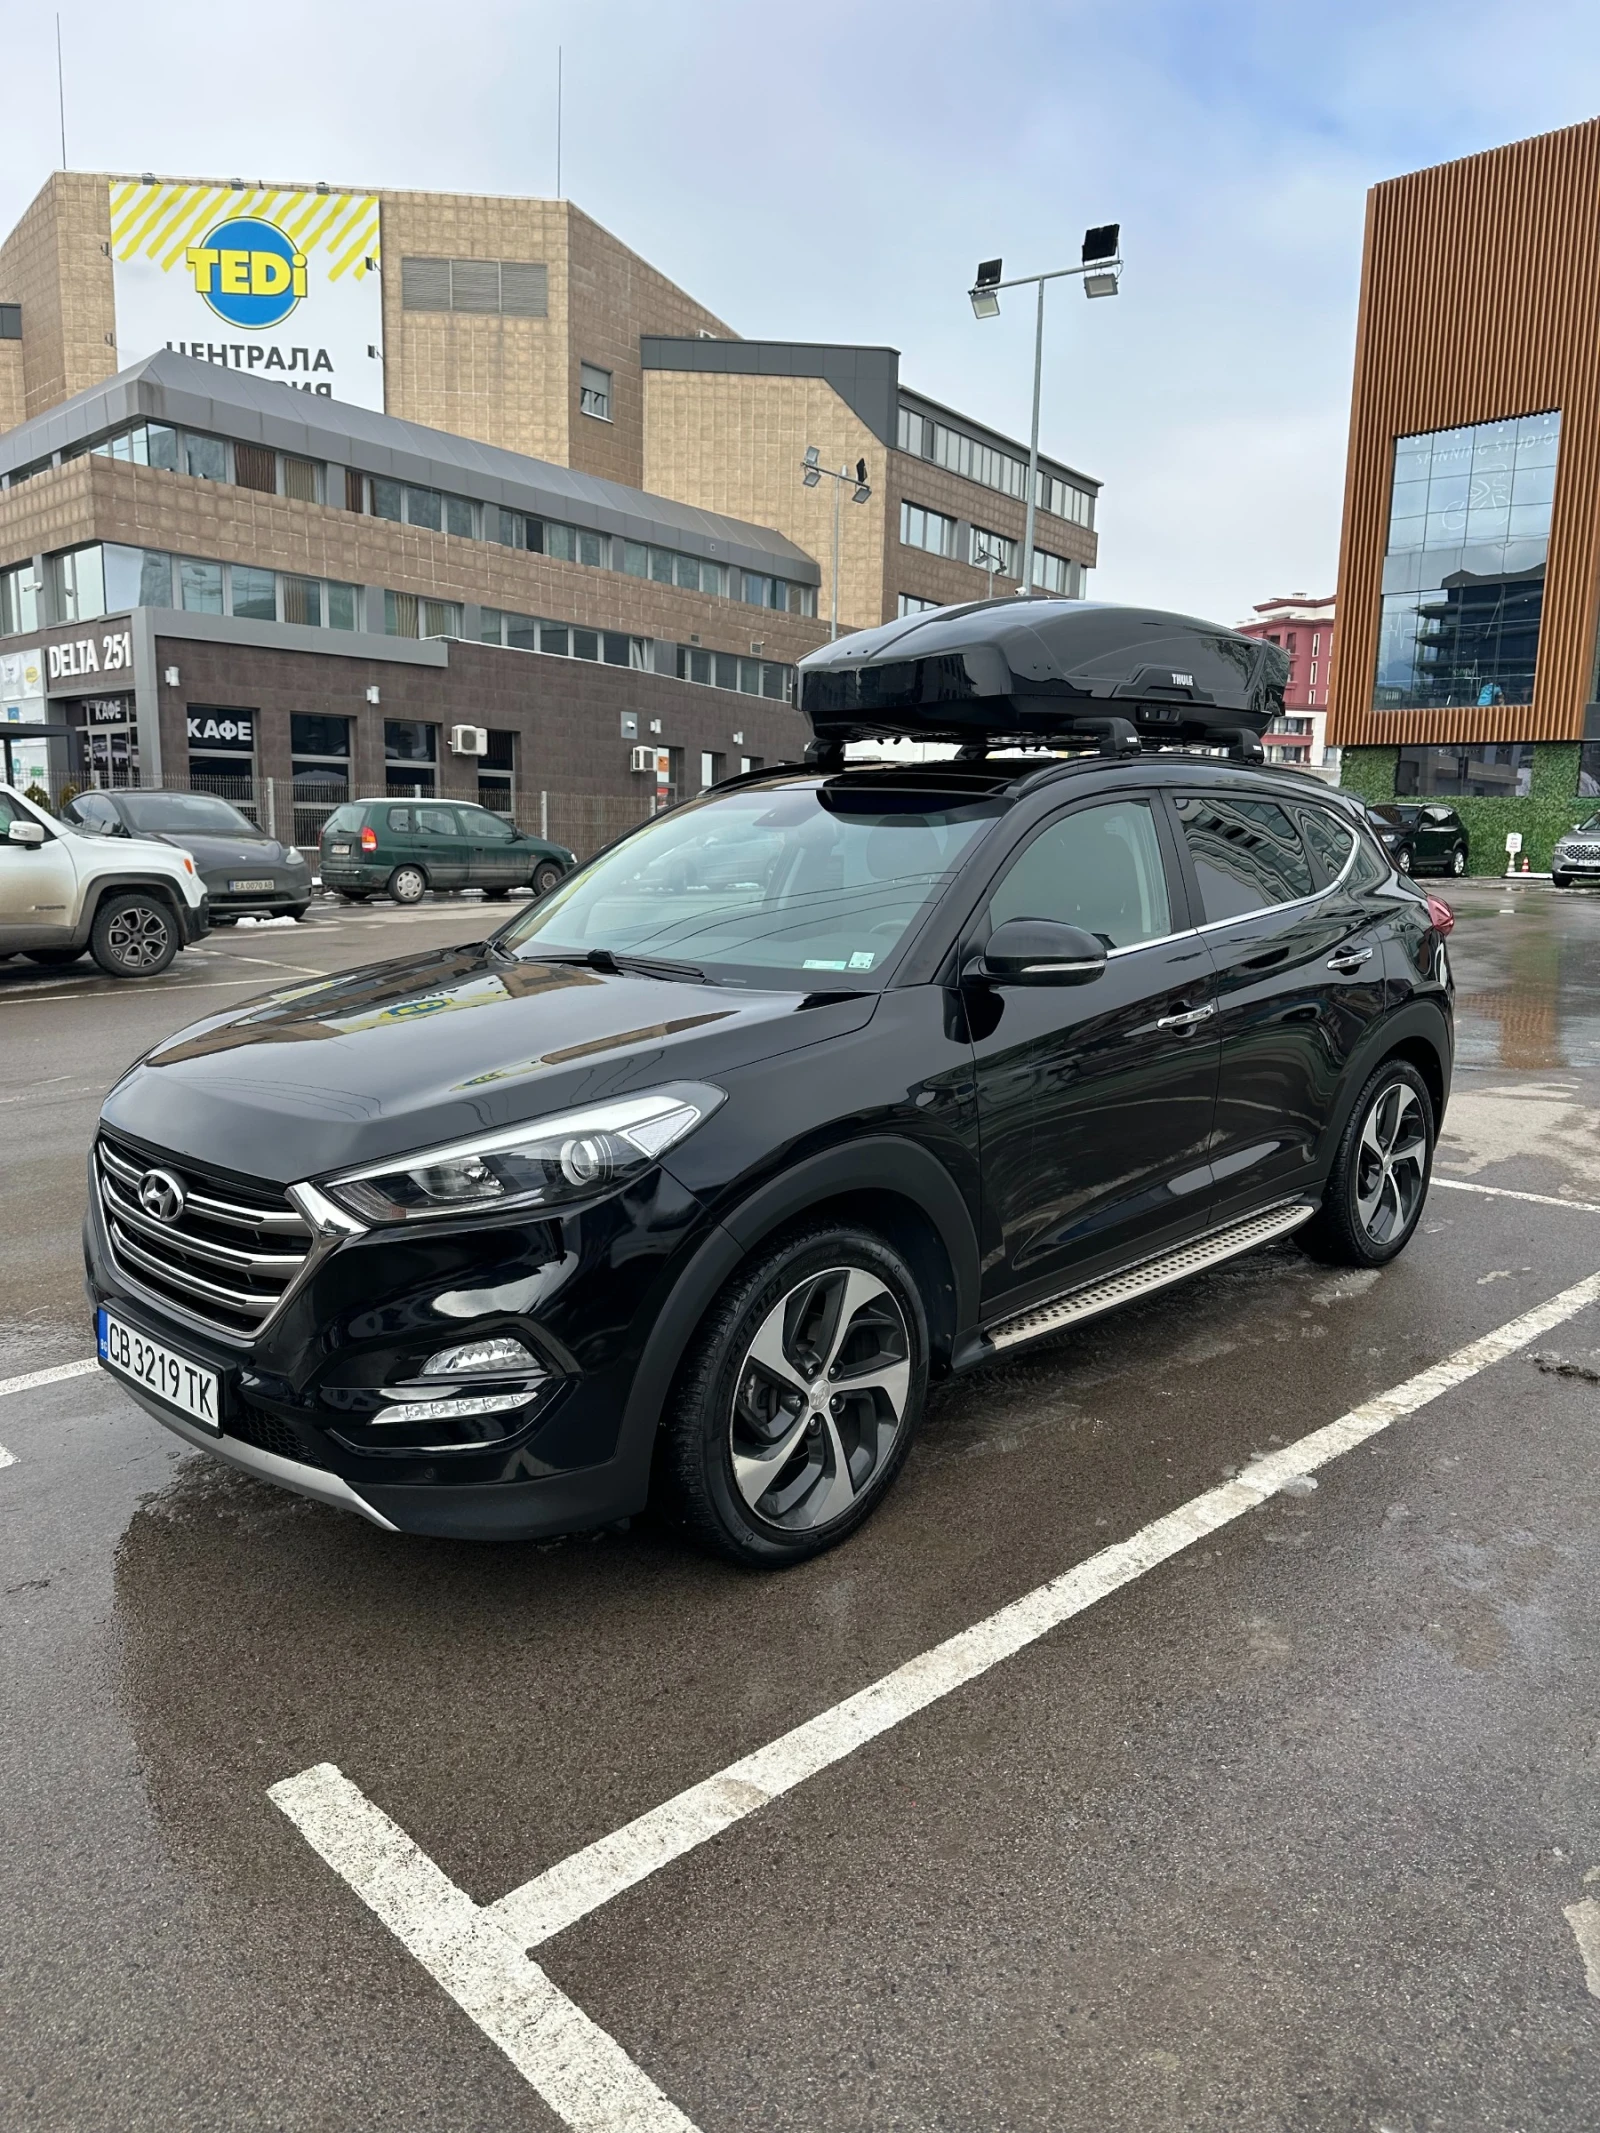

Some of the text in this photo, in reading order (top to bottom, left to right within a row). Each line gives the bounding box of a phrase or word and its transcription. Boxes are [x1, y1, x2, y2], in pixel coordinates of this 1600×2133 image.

[186, 247, 307, 297] TEDi
[1415, 432, 1555, 465] SPINNING STUDIO
[48, 639, 100, 678] DELTA
[103, 631, 132, 670] 251
[1171, 673, 1194, 686] THULE
[95, 700, 121, 720] КАФЕ
[187, 718, 252, 741] КАФЕ
[109, 1322, 214, 1419] CB 3219 TK
